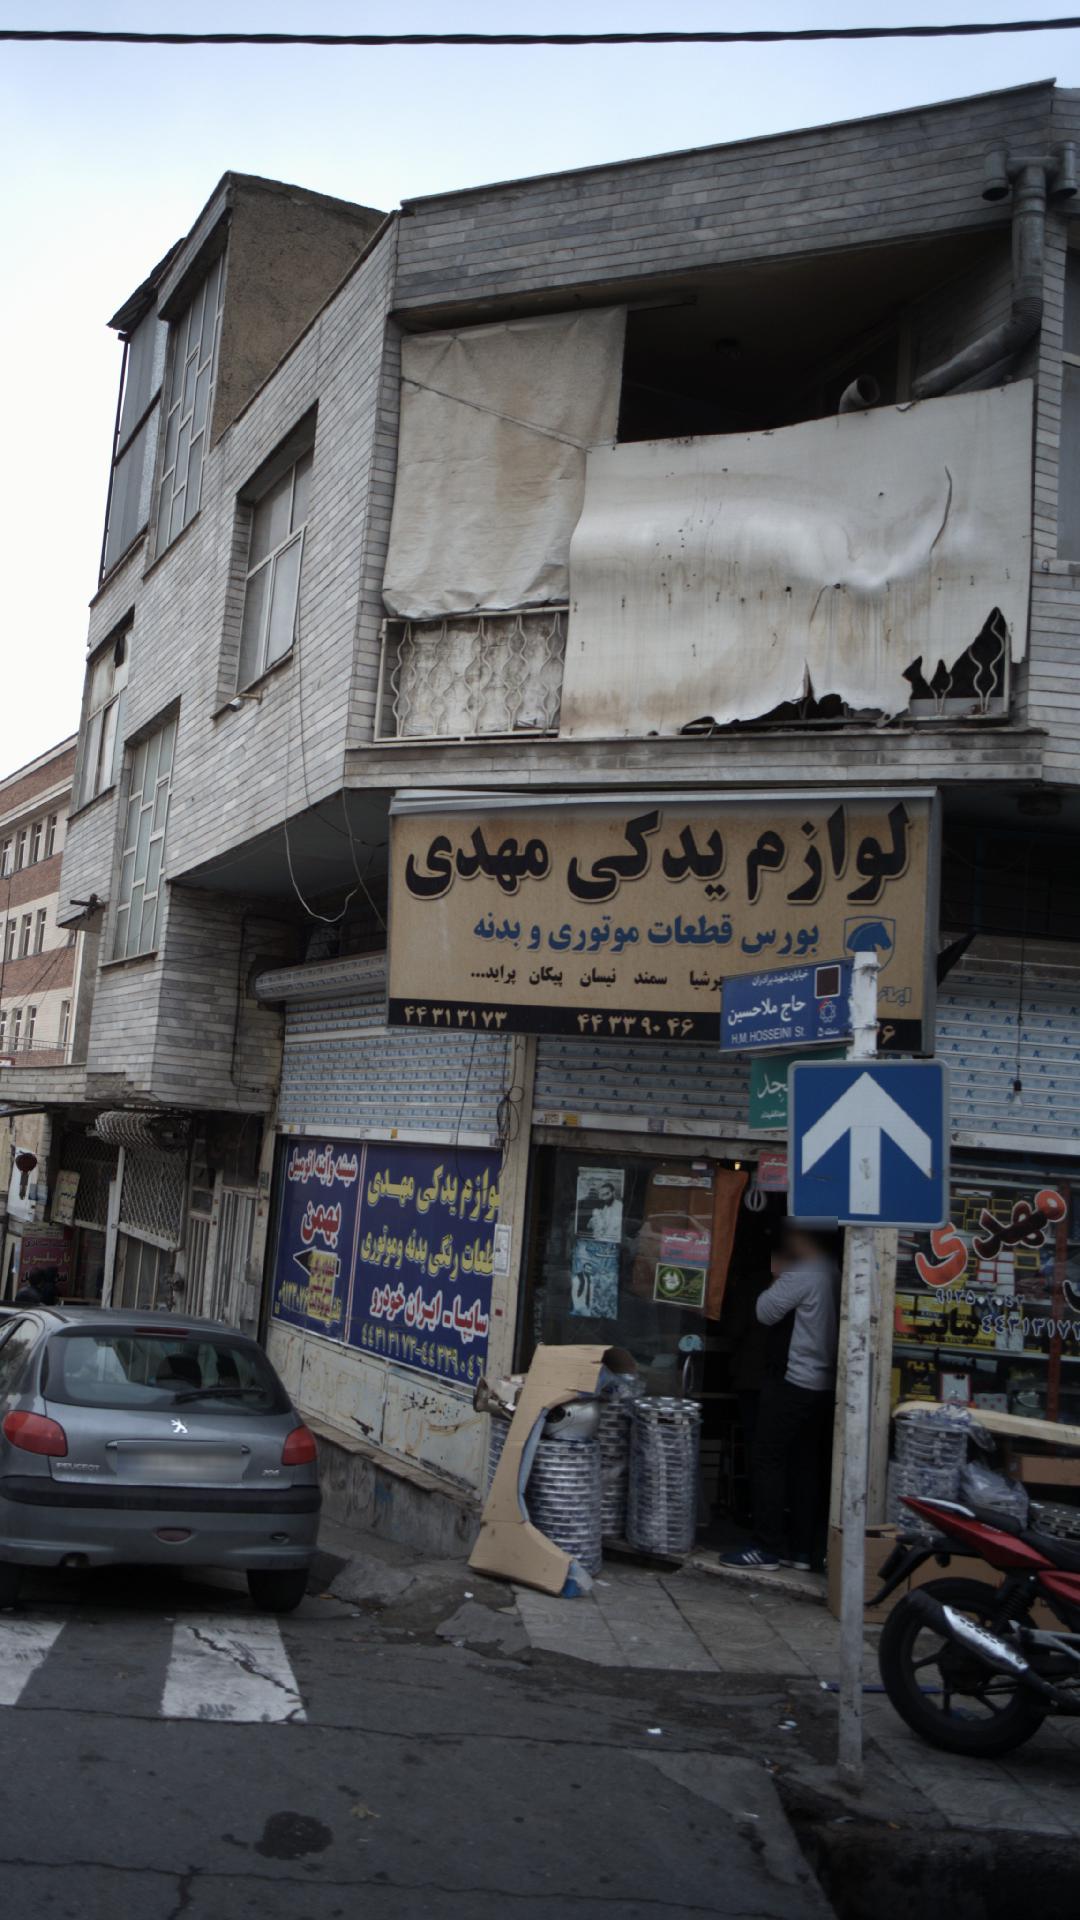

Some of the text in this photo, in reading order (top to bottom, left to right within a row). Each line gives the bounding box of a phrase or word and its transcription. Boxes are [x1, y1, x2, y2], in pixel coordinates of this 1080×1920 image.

[404, 801, 911, 905] لوازم یدکی مهدی
[473, 912, 820, 955] بورس قطعات موتوری و بدنه
[529, 966, 562, 987] پیکان
[579, 968, 617, 987] نیسان
[634, 971, 668, 985] سمند
[780, 994, 806, 1022] حاج
[367, 1164, 499, 1222] وازم یدکی مهدی
[301, 1200, 342, 1250] بهمن
[914, 1188, 1068, 1288] مهدی
[427, 1233, 459, 1282] رنگی
[369, 1282, 406, 1321] خودرو
[404, 1285, 443, 1331] ایران
[55, 1462, 100, 1472] PEUGEOT
